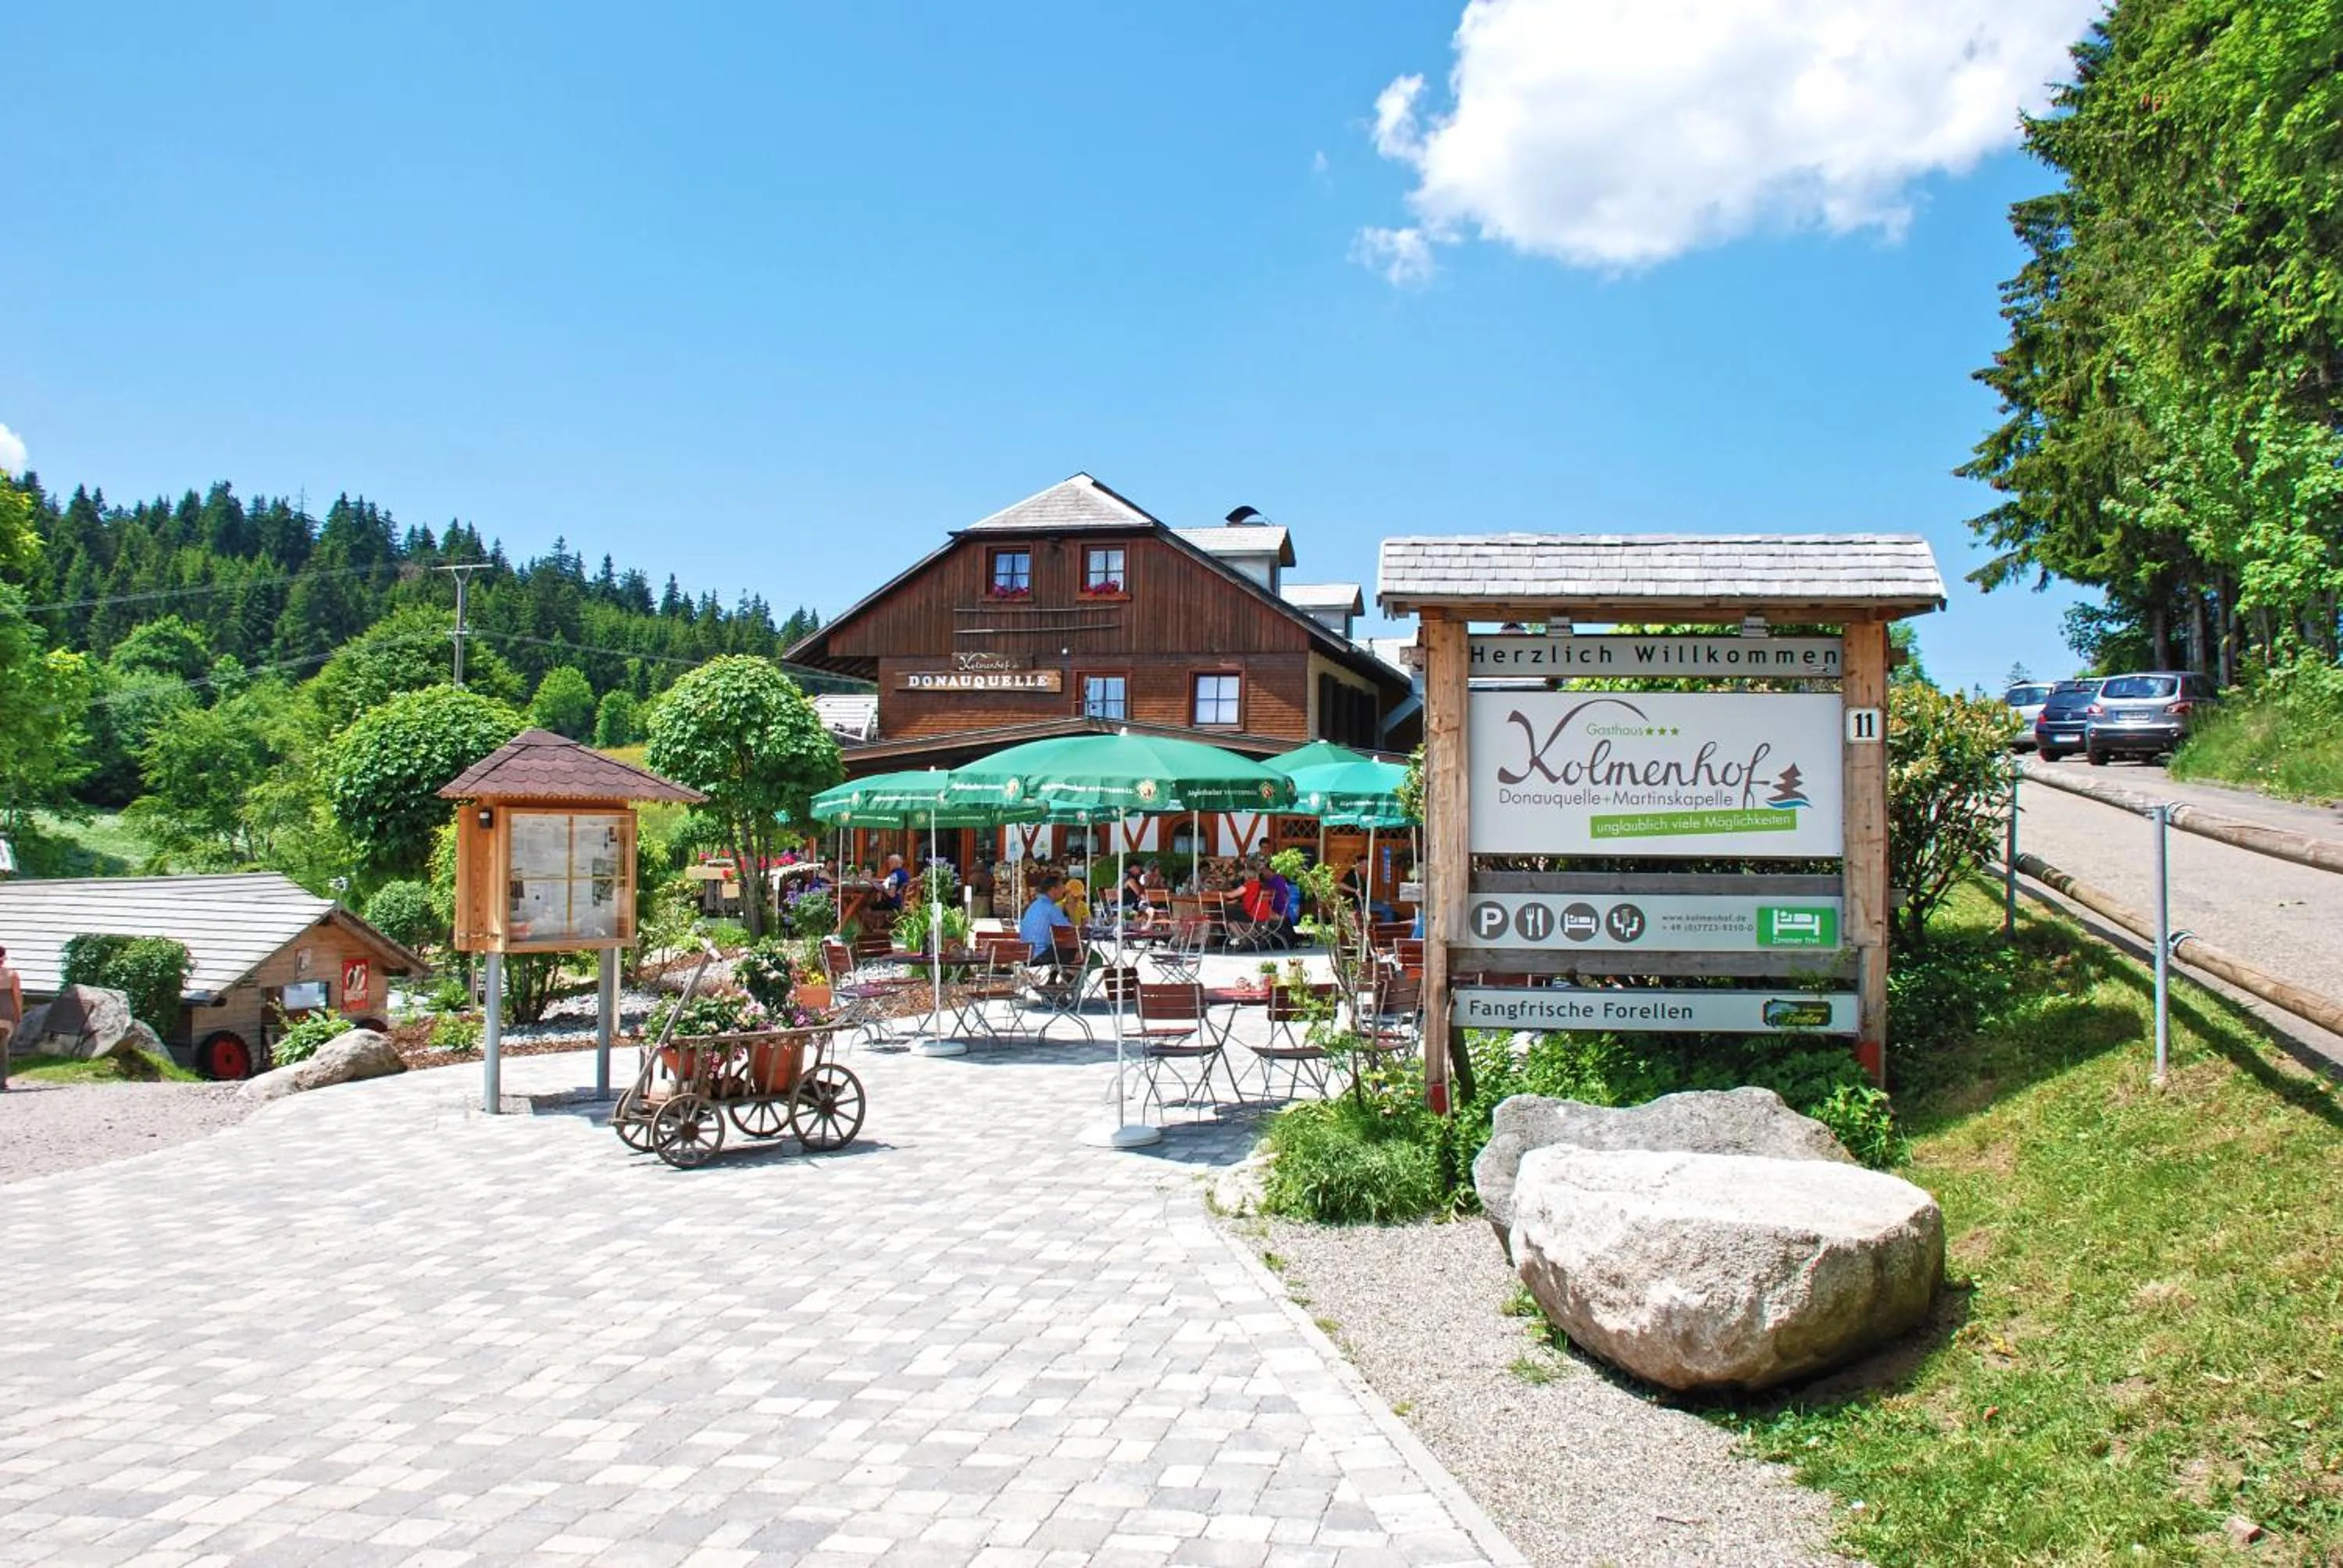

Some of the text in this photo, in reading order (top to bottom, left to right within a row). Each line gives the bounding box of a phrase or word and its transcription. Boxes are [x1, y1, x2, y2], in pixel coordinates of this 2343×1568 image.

[1471, 645, 1837, 665] Herzlich Willkommen
[908, 675, 1048, 690] DONAUQUELLE
[1586, 722, 1644, 736] Gasthaus
[1854, 712, 1874, 738] 11
[1497, 699, 1771, 809] Kolmenhof
[1596, 813, 1791, 835] unglaublich viele Möglichkeiten
[1469, 1000, 1694, 1021] Fangfrische Forellen
